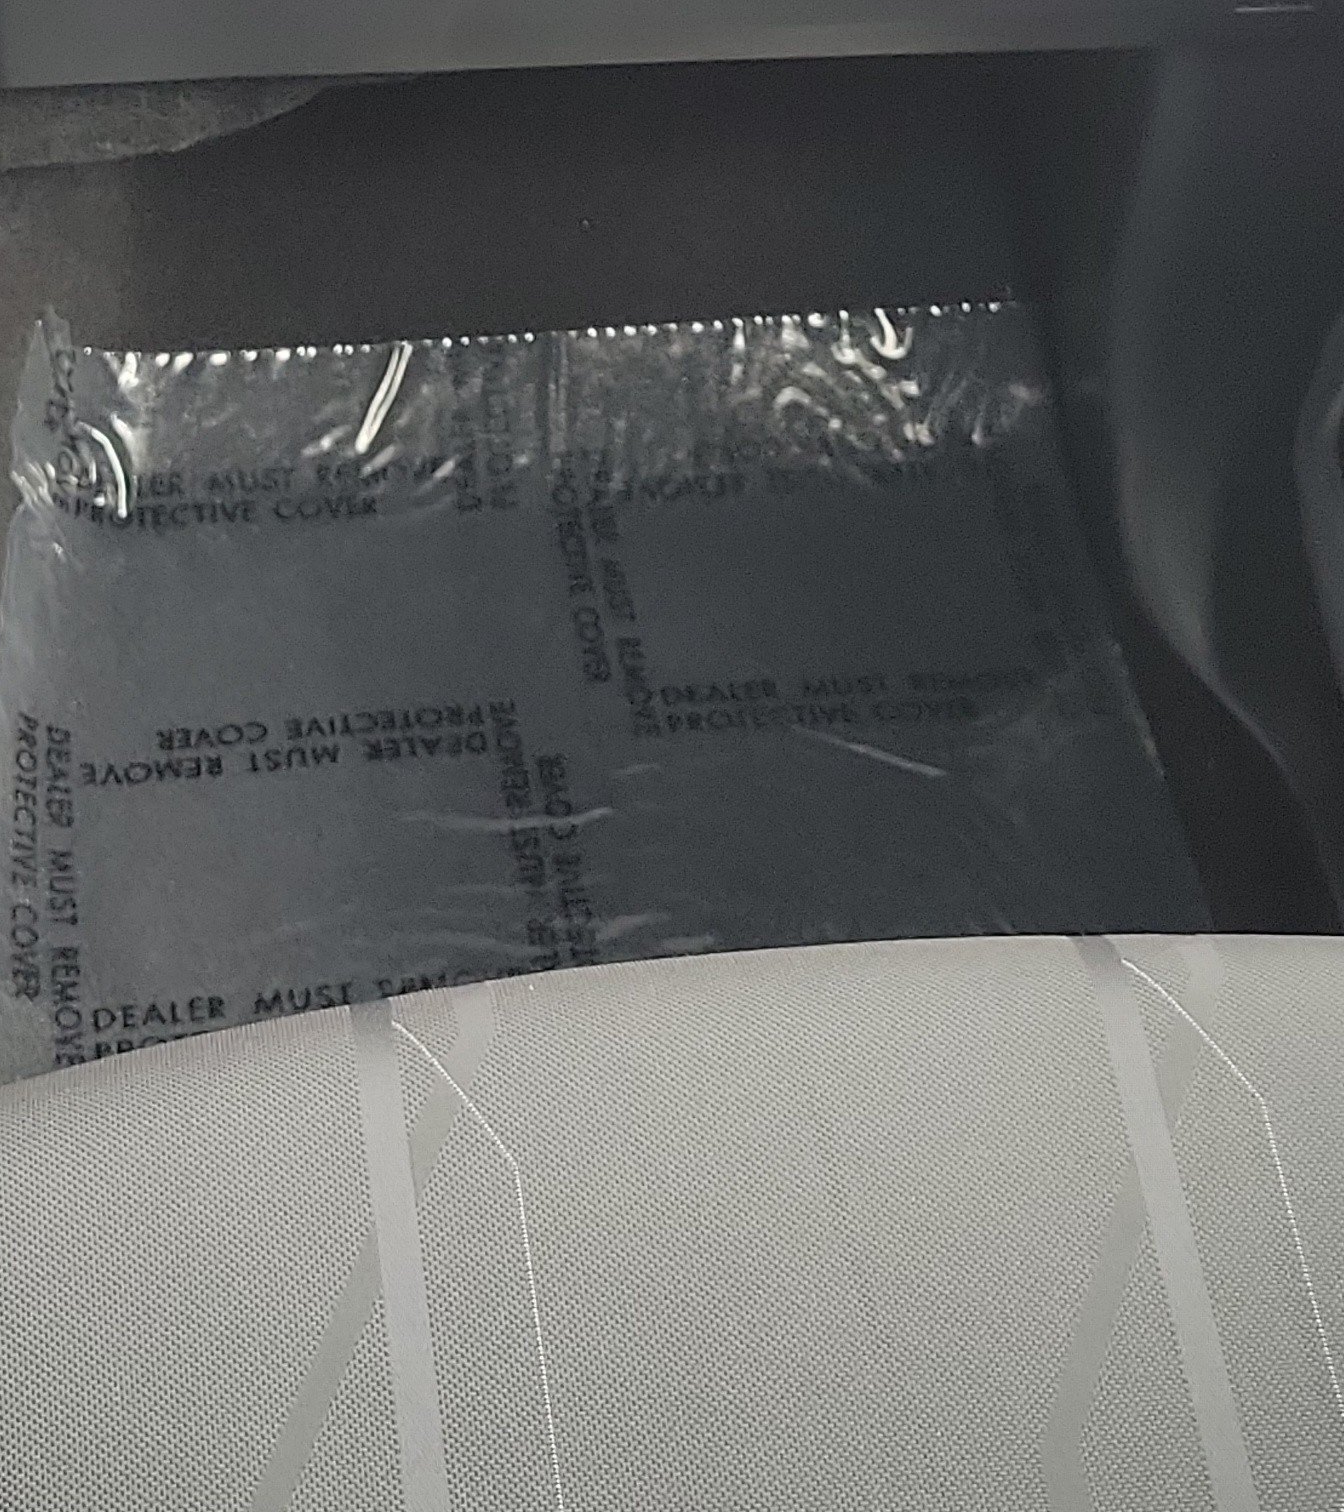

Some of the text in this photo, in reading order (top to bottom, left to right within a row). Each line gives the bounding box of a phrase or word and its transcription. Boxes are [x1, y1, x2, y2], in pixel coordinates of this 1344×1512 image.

[78, 729, 489, 788] DEALER MUST REMOVE
[156, 703, 487, 752] PROTECTIVE COVER
[45, 722, 74, 830] DEALER
[9, 709, 42, 1002] PROTECTIVE COVER
[45, 848, 79, 928] MUST
[91, 994, 228, 1032] DEALER
[255, 981, 354, 1016] MUST
